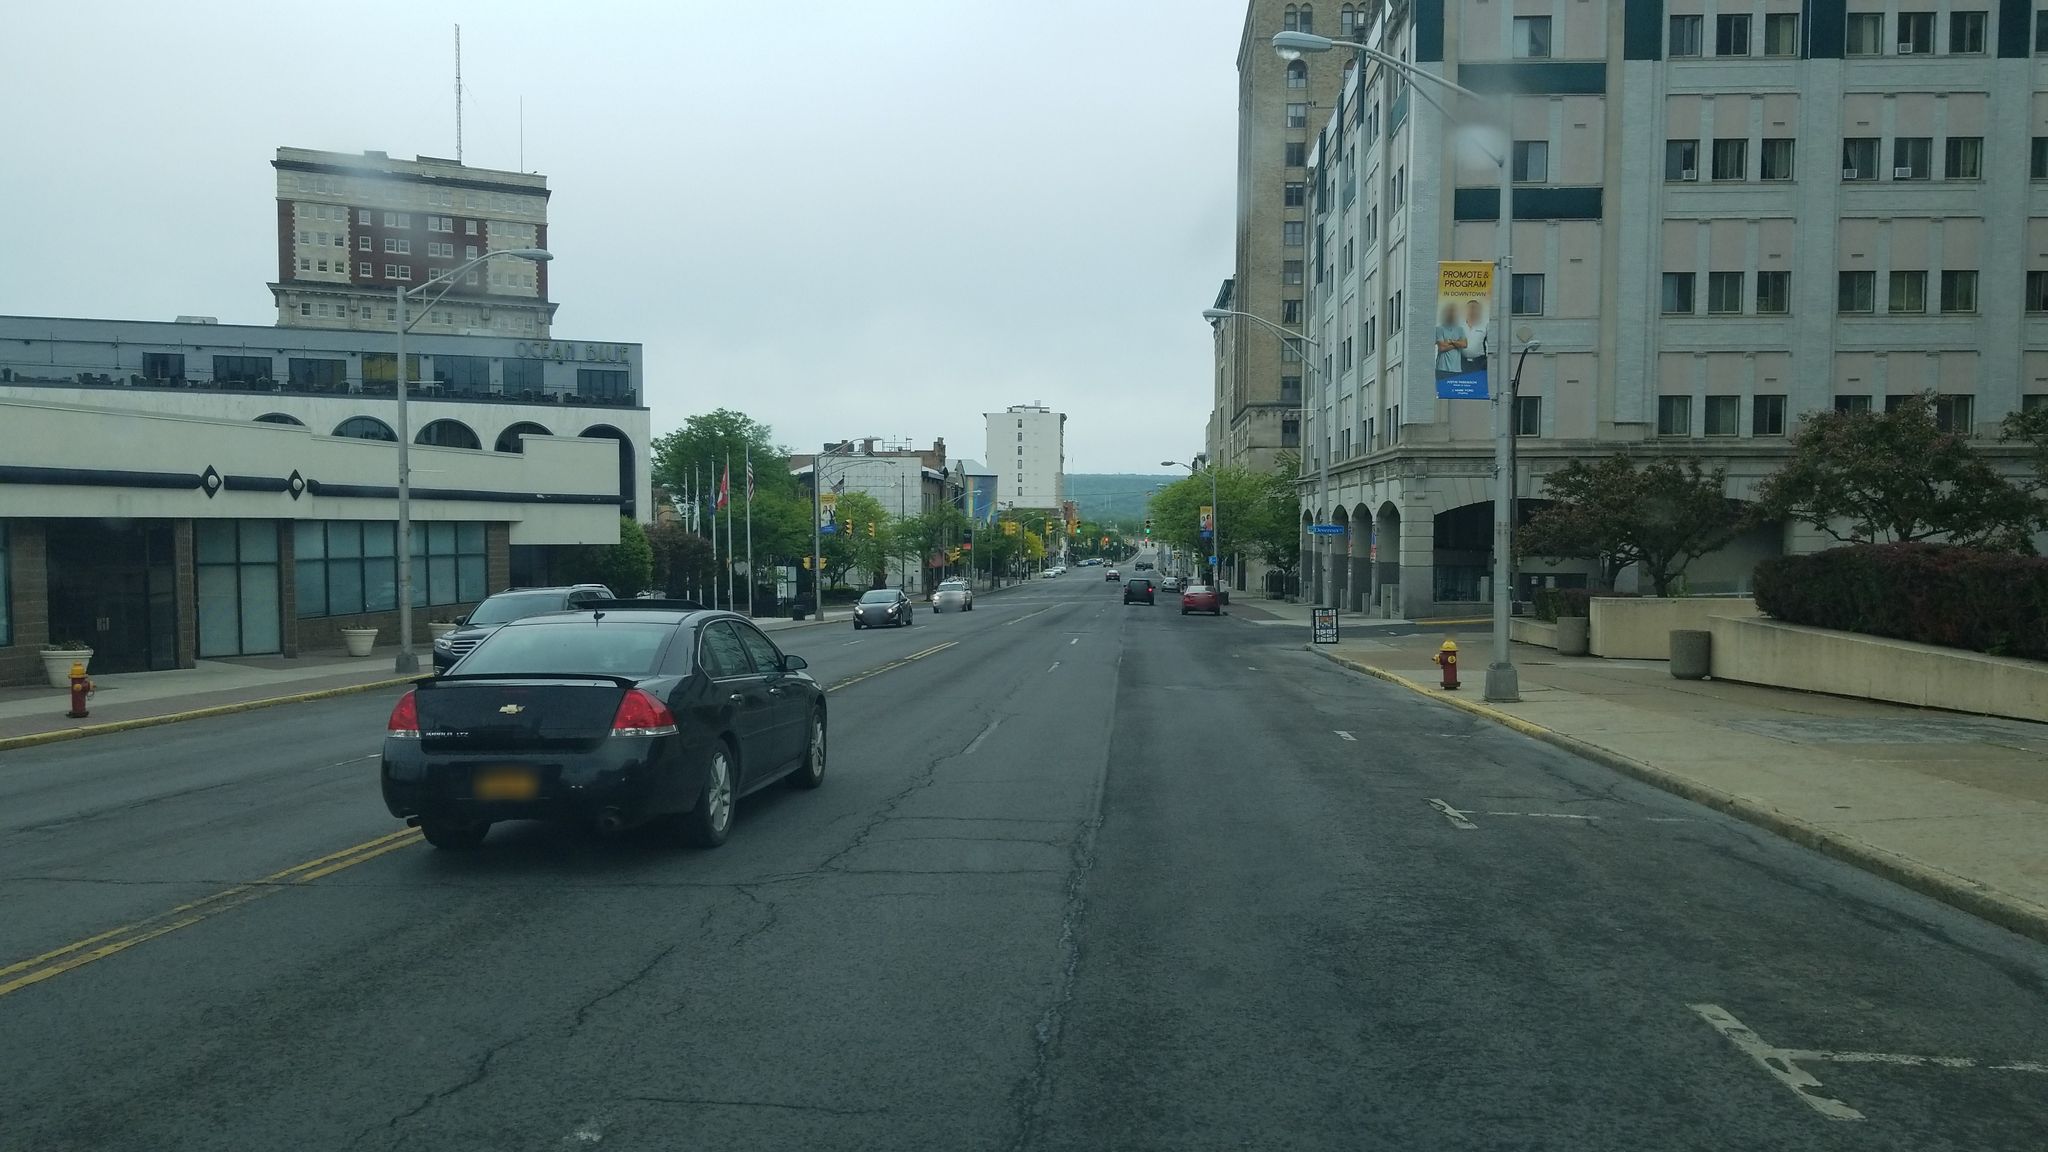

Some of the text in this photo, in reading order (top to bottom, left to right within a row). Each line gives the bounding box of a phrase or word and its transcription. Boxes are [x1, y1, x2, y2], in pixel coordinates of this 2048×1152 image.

[1443, 270, 1489, 279] PROMOTE &
[1444, 279, 1487, 288] PROGRAM
[515, 342, 629, 362] OCEAN BLUE
